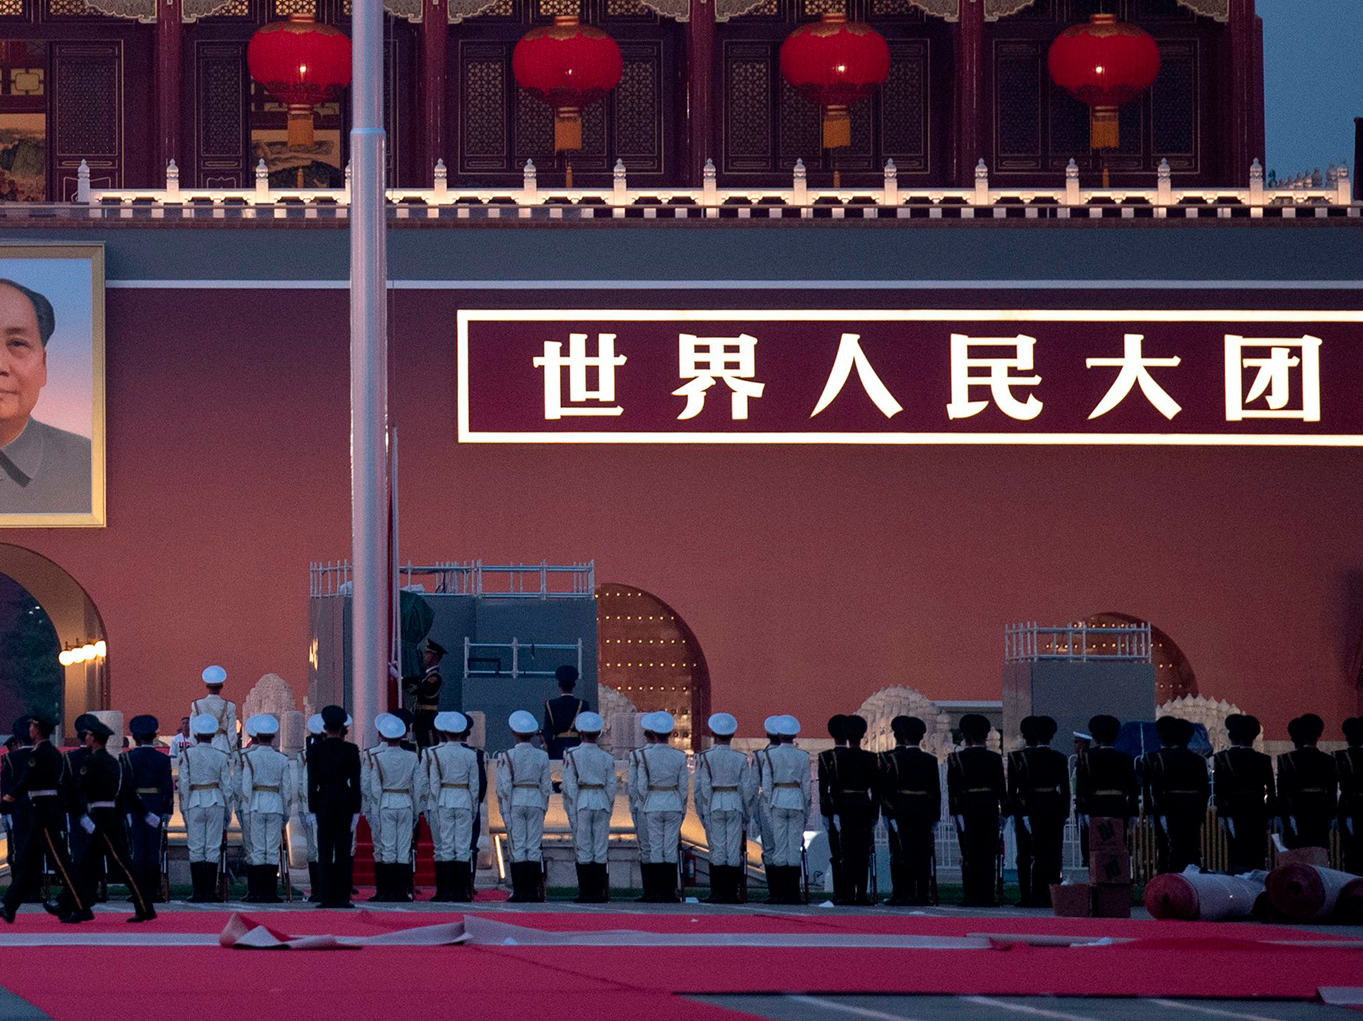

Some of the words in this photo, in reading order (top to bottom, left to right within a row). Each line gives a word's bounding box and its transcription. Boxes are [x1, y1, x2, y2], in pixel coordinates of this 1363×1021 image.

[532, 333, 1323, 422] 世界人民大团
